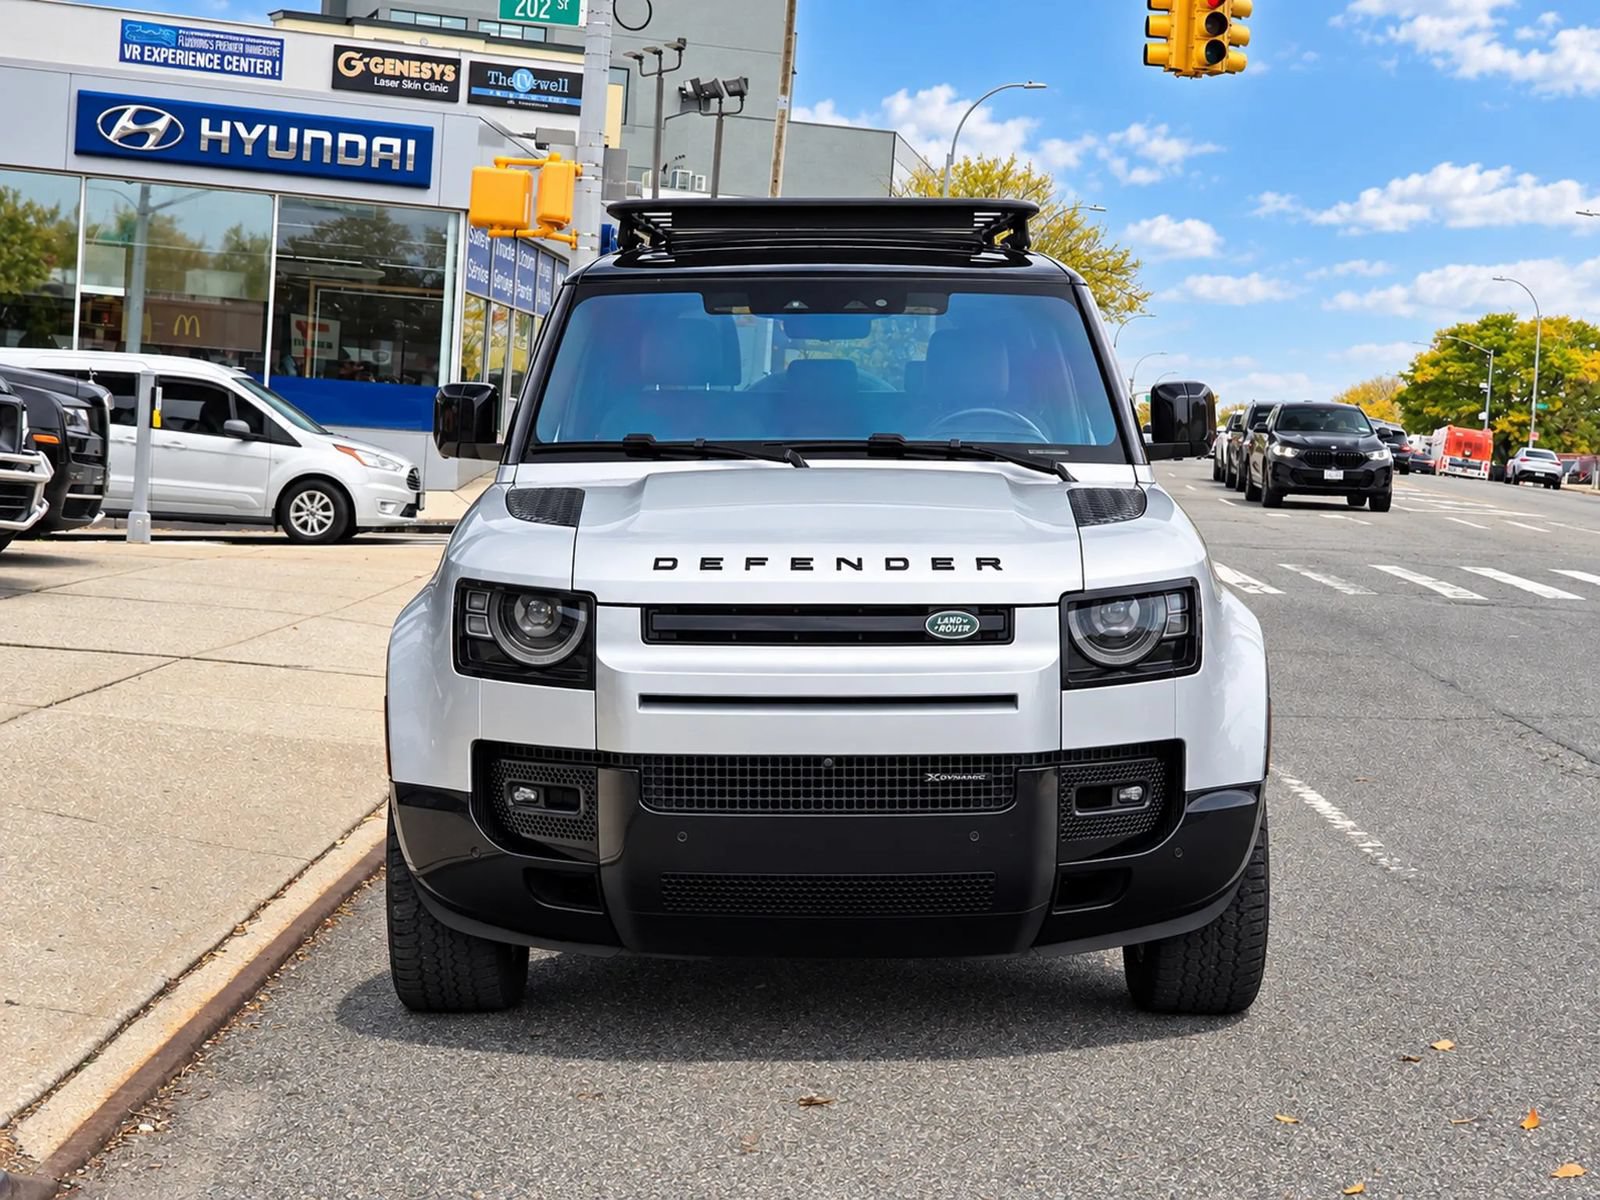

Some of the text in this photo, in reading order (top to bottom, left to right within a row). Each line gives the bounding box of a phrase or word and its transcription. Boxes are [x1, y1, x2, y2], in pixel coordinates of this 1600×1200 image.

[514, 0, 551, 19] 202
[124, 43, 141, 60] VR
[143, 46, 221, 70] EXPERIENCE
[223, 55, 273, 75] CENTER
[369, 56, 456, 82] GENESYS
[374, 76, 449, 93] Laser Skin Clinic
[200, 117, 416, 172] HYUNDAI
[652, 557, 1003, 571] DEFENDER
[936, 616, 963, 625] LAND
[938, 624, 971, 633] ROVER
